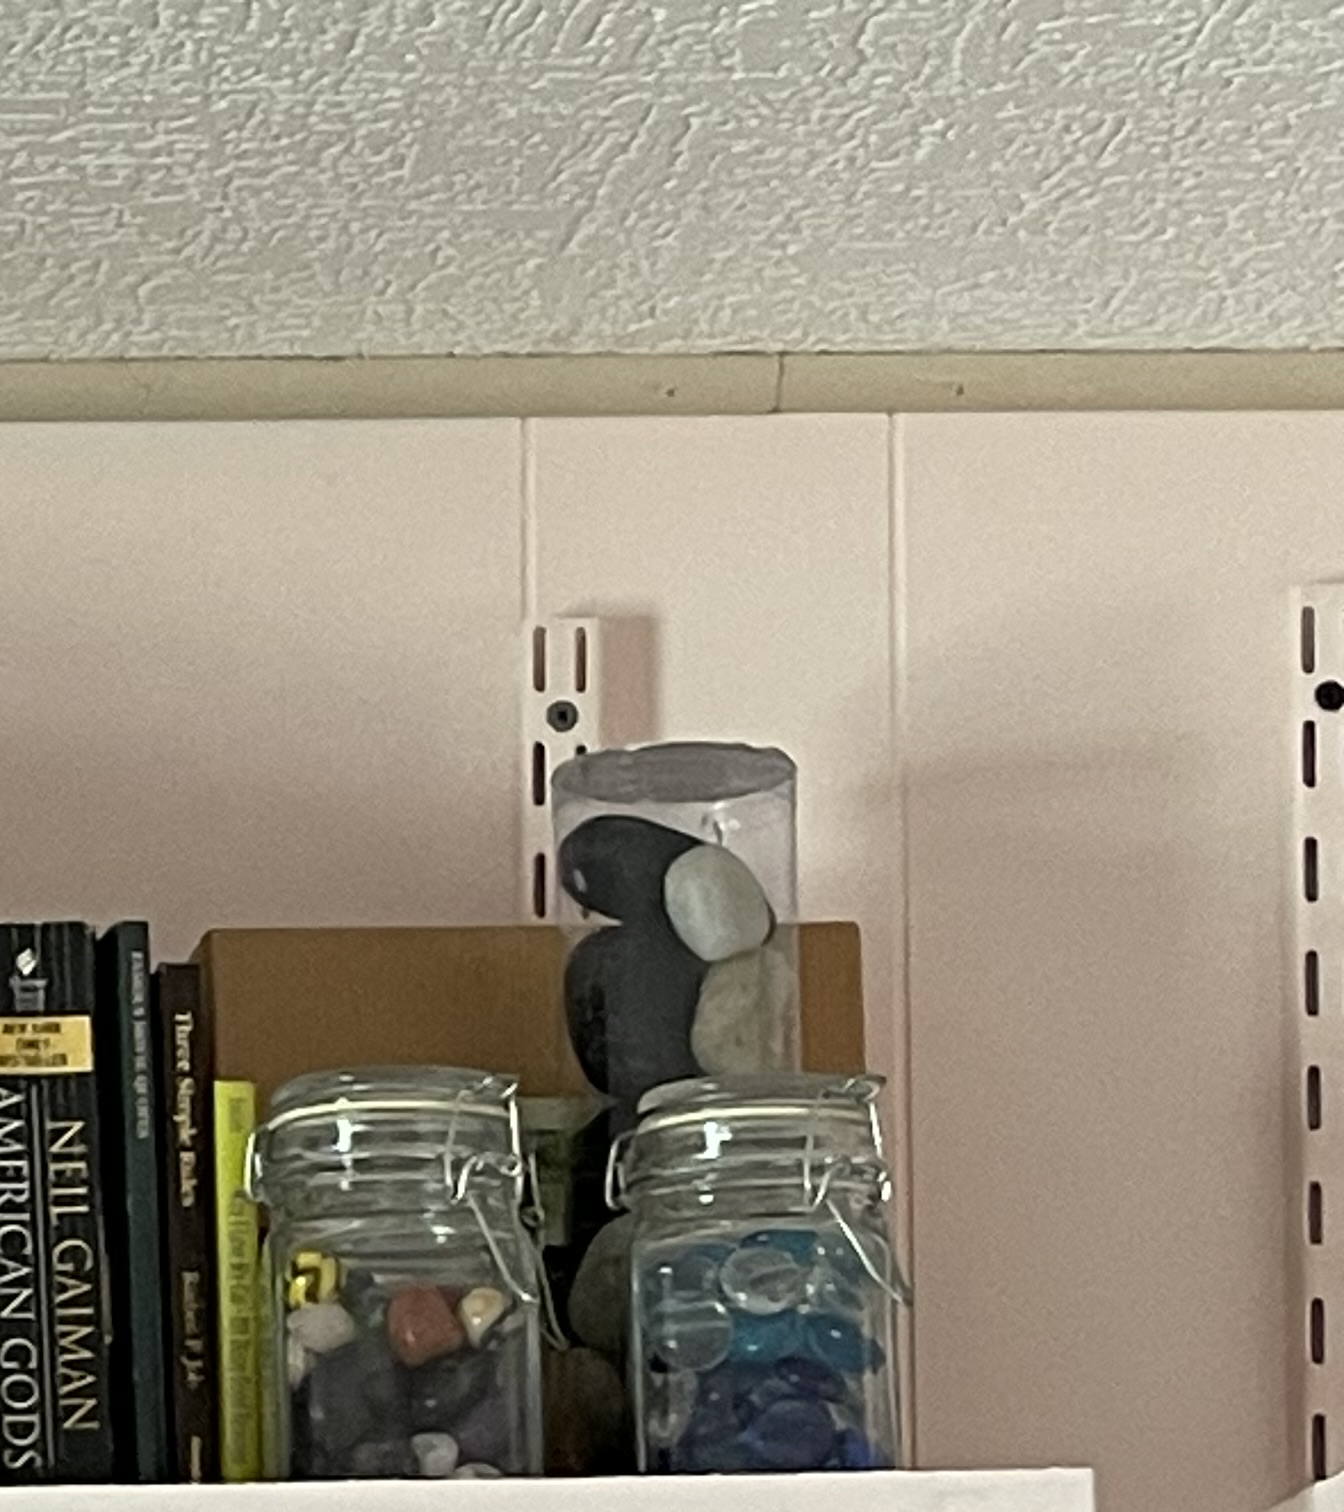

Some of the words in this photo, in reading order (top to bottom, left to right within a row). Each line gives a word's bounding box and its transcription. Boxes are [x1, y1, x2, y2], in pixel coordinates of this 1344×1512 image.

[173, 1011, 194, 1073] Three
[46, 1119, 91, 1228] NEIL
[52, 1238, 101, 1431] GAIMAN
